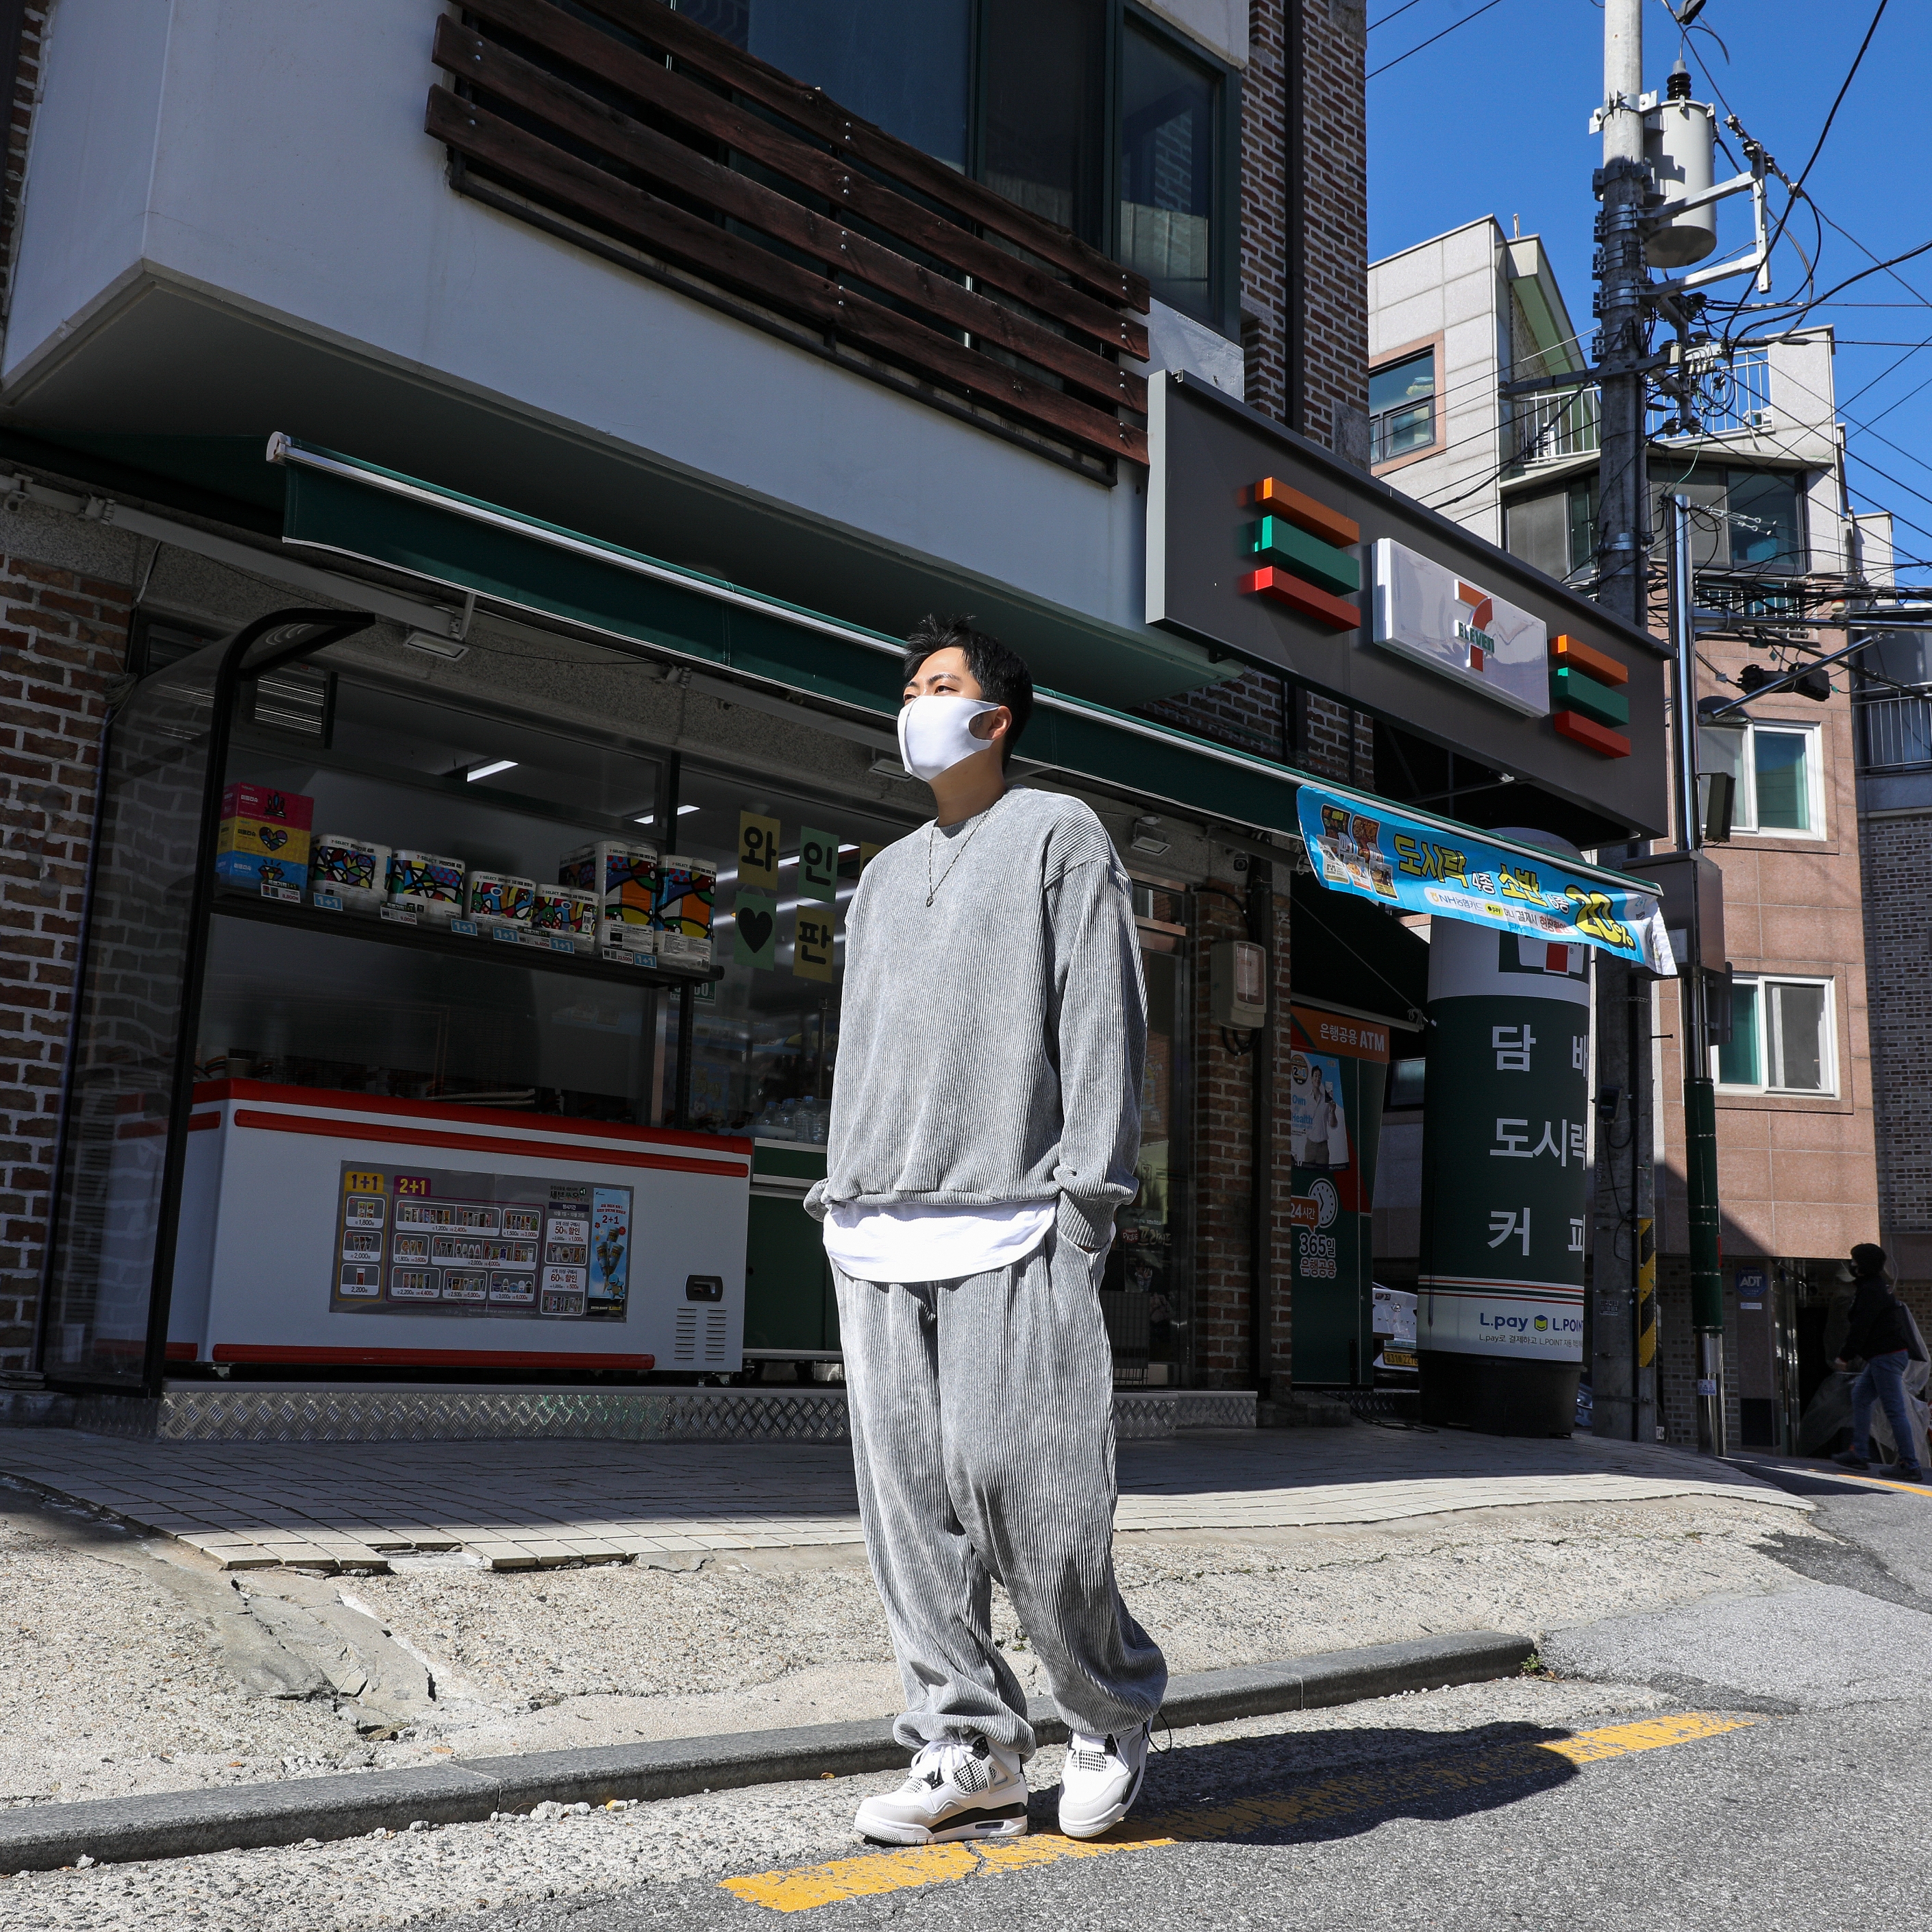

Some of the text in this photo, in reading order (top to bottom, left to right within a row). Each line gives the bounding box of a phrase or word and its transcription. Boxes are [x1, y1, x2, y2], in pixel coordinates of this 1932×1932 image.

[1394, 833, 1470, 889] 도시락
[1472, 871, 1496, 895] 4종
[1564, 884, 1637, 951] 20%
[317, 895, 338, 908] 1+1
[455, 922, 473, 933] 1+1
[496, 929, 515, 941] 1+1
[554, 939, 571, 950] 1+1
[636, 956, 654, 965] 1+1
[1320, 1023, 1385, 1052] 은행공용 ATM
[351, 1174, 377, 1190] 1+1
[399, 1178, 427, 1195] 2+1
[1291, 1202, 1315, 1220] 24시간
[602, 1215, 619, 1224] 2+1
[568, 1226, 580, 1235] 할인
[1300, 1233, 1337, 1258] 365일
[1300, 1257, 1337, 1278] 은행공용
[565, 1275, 578, 1283] 할인
[1739, 1276, 1762, 1287] ADT
[1481, 1313, 1528, 1332] L.pay
[1509, 1335, 1537, 1345] 결제하고
